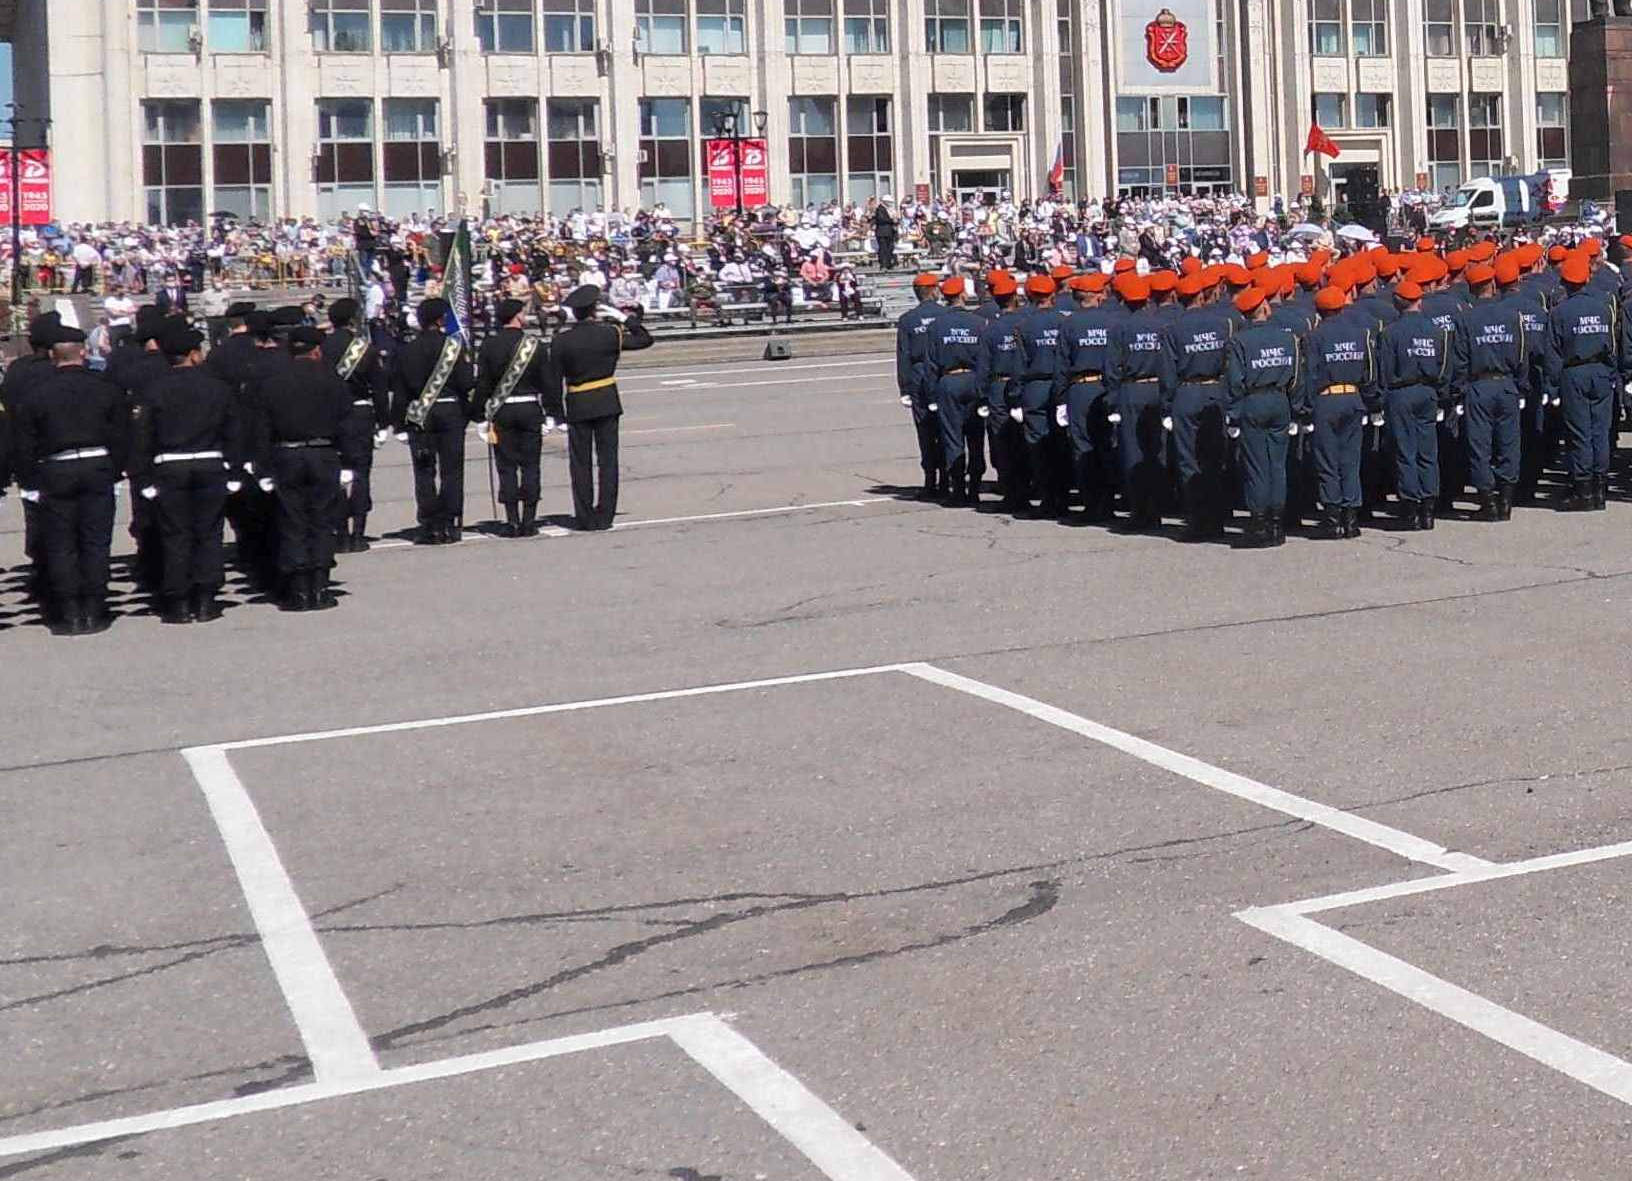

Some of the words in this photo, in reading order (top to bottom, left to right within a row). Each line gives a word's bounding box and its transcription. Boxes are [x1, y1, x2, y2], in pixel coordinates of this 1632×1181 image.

[1193, 332, 1216, 342] МЧС
[1260, 347, 1285, 358] МЧС
[1334, 342, 1357, 352] МЧС
[1325, 351, 1364, 362] РОССИИ
[1251, 356, 1292, 369] РОССИИ
